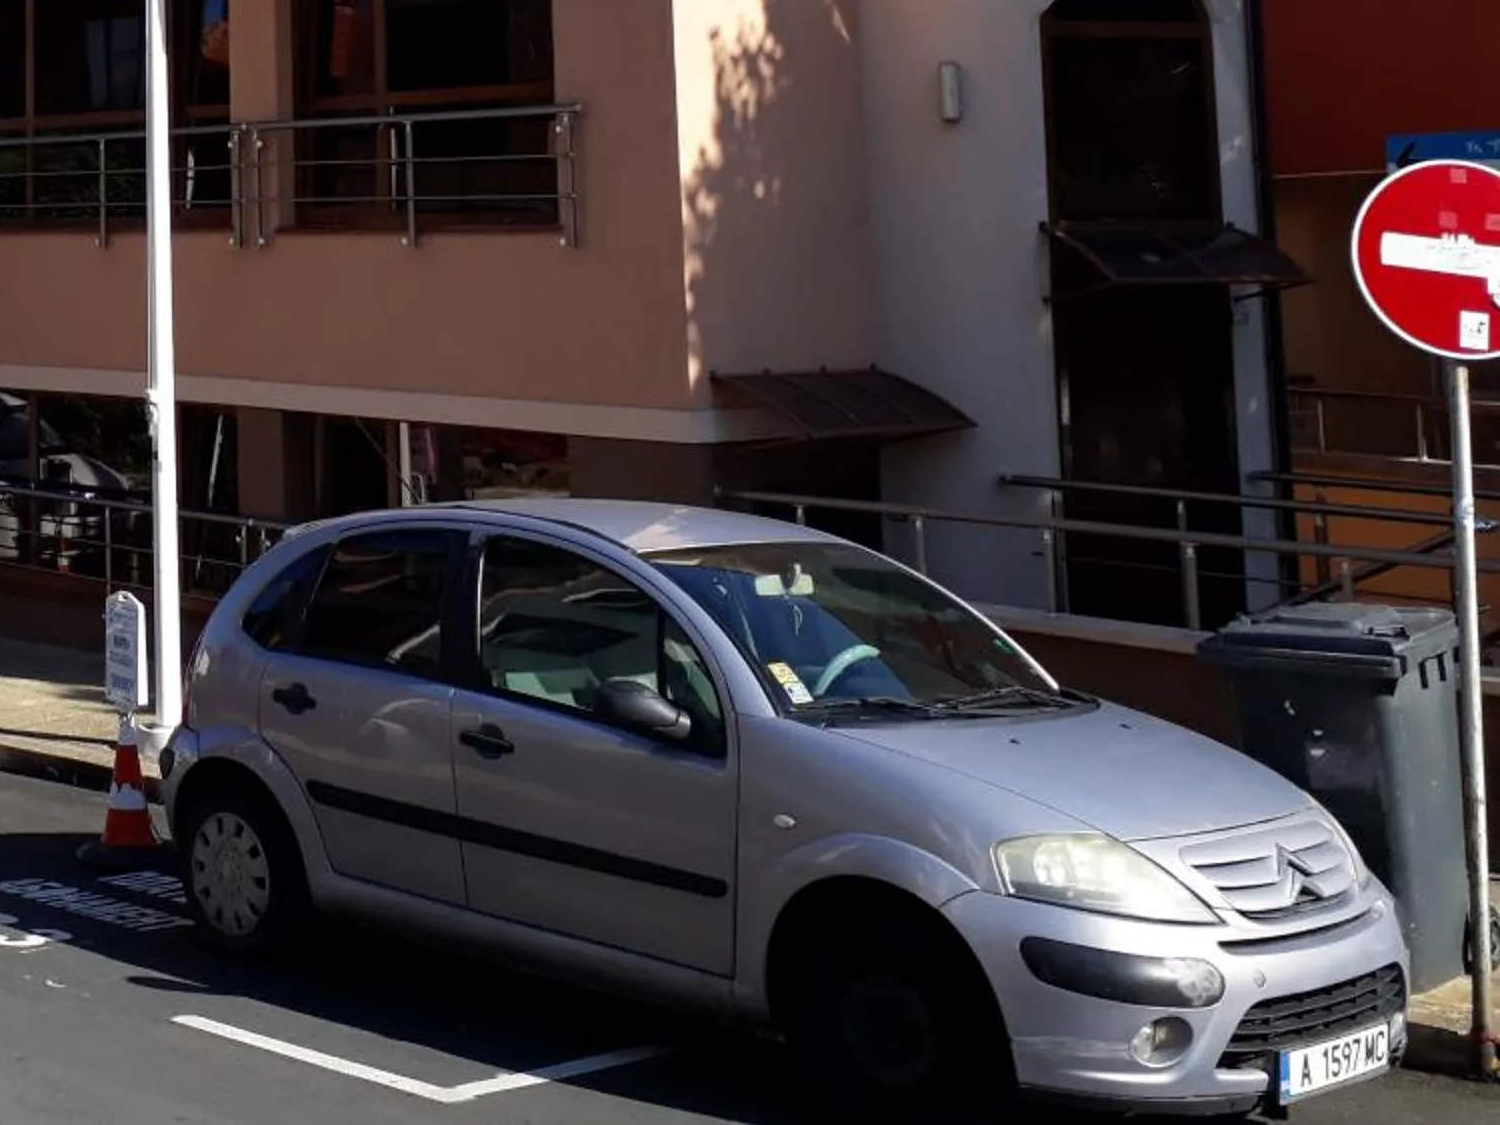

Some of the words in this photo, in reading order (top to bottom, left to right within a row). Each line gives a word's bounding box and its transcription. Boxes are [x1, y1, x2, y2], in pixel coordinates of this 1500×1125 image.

[1300, 1053, 1312, 1087] A
[1322, 1038, 1361, 1080] 1597
[1364, 1030, 1385, 1067] MC
